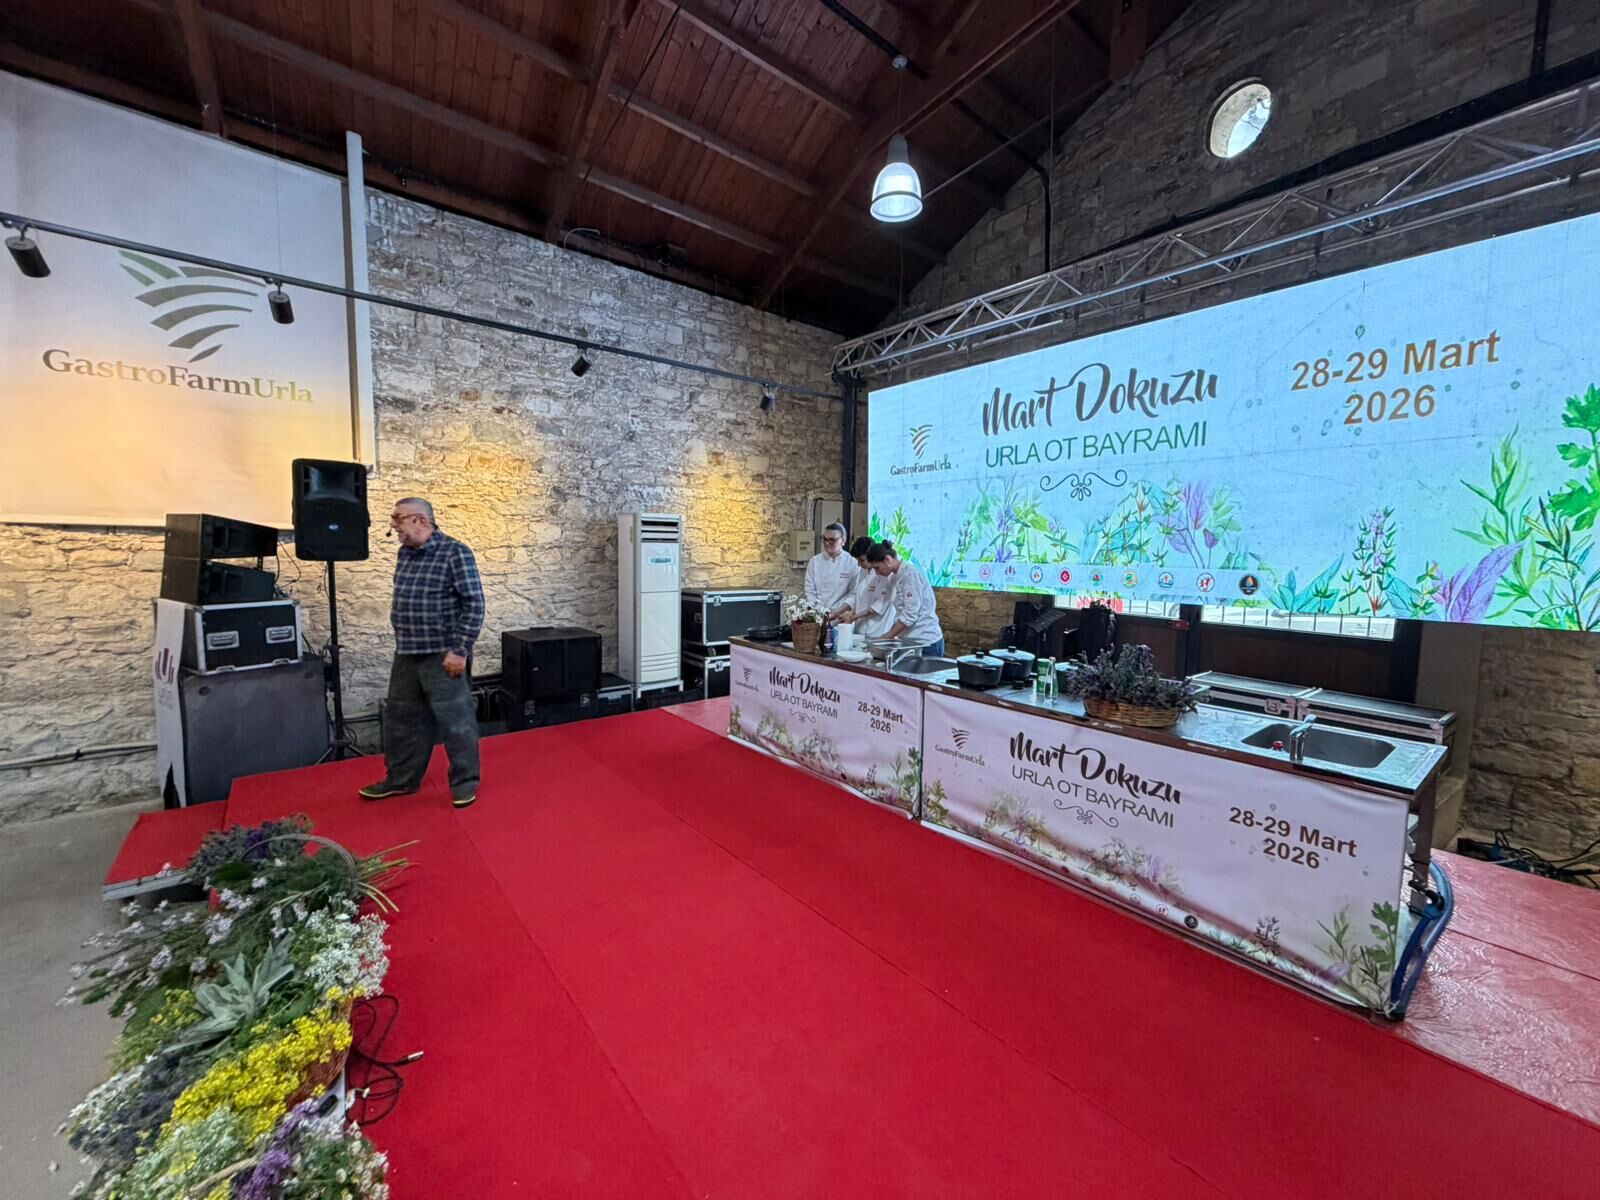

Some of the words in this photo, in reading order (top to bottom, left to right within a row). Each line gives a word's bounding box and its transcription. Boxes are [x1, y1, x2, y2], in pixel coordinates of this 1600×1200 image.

[42, 349, 313, 403] GastroFarmUrla
[1291, 348, 1388, 391] 28-29
[1403, 329, 1501, 376] Mart
[982, 376, 1064, 436] Mart
[1064, 362, 1218, 422] Dokuzu
[1343, 384, 1436, 425] 2026
[985, 445, 1041, 468] URLA
[1043, 437, 1078, 463] OT
[1083, 420, 1208, 459] BAYRAMI
[890, 453, 952, 477] GastroFarmUrla
[769, 666, 797, 690] Mart
[797, 672, 841, 704] Dokuzu
[770, 688, 790, 704] URLA
[790, 693, 801, 707] OT
[802, 701, 838, 719] BAYRAMI
[857, 701, 881, 717] 28-29
[883, 708, 904, 724] Mart
[869, 717, 892, 733] 2026
[934, 743, 985, 767] GastroFarmUrla
[1010, 731, 1074, 773] Mart
[1074, 747, 1182, 805] Dokuzu
[1011, 765, 1055, 789] URLA
[1056, 779, 1081, 800] OT
[1085, 788, 1175, 829] BAYRAMI
[1228, 806, 1291, 838] 28-29
[1299, 824, 1357, 858] Mart
[1262, 837, 1321, 870] 2026
